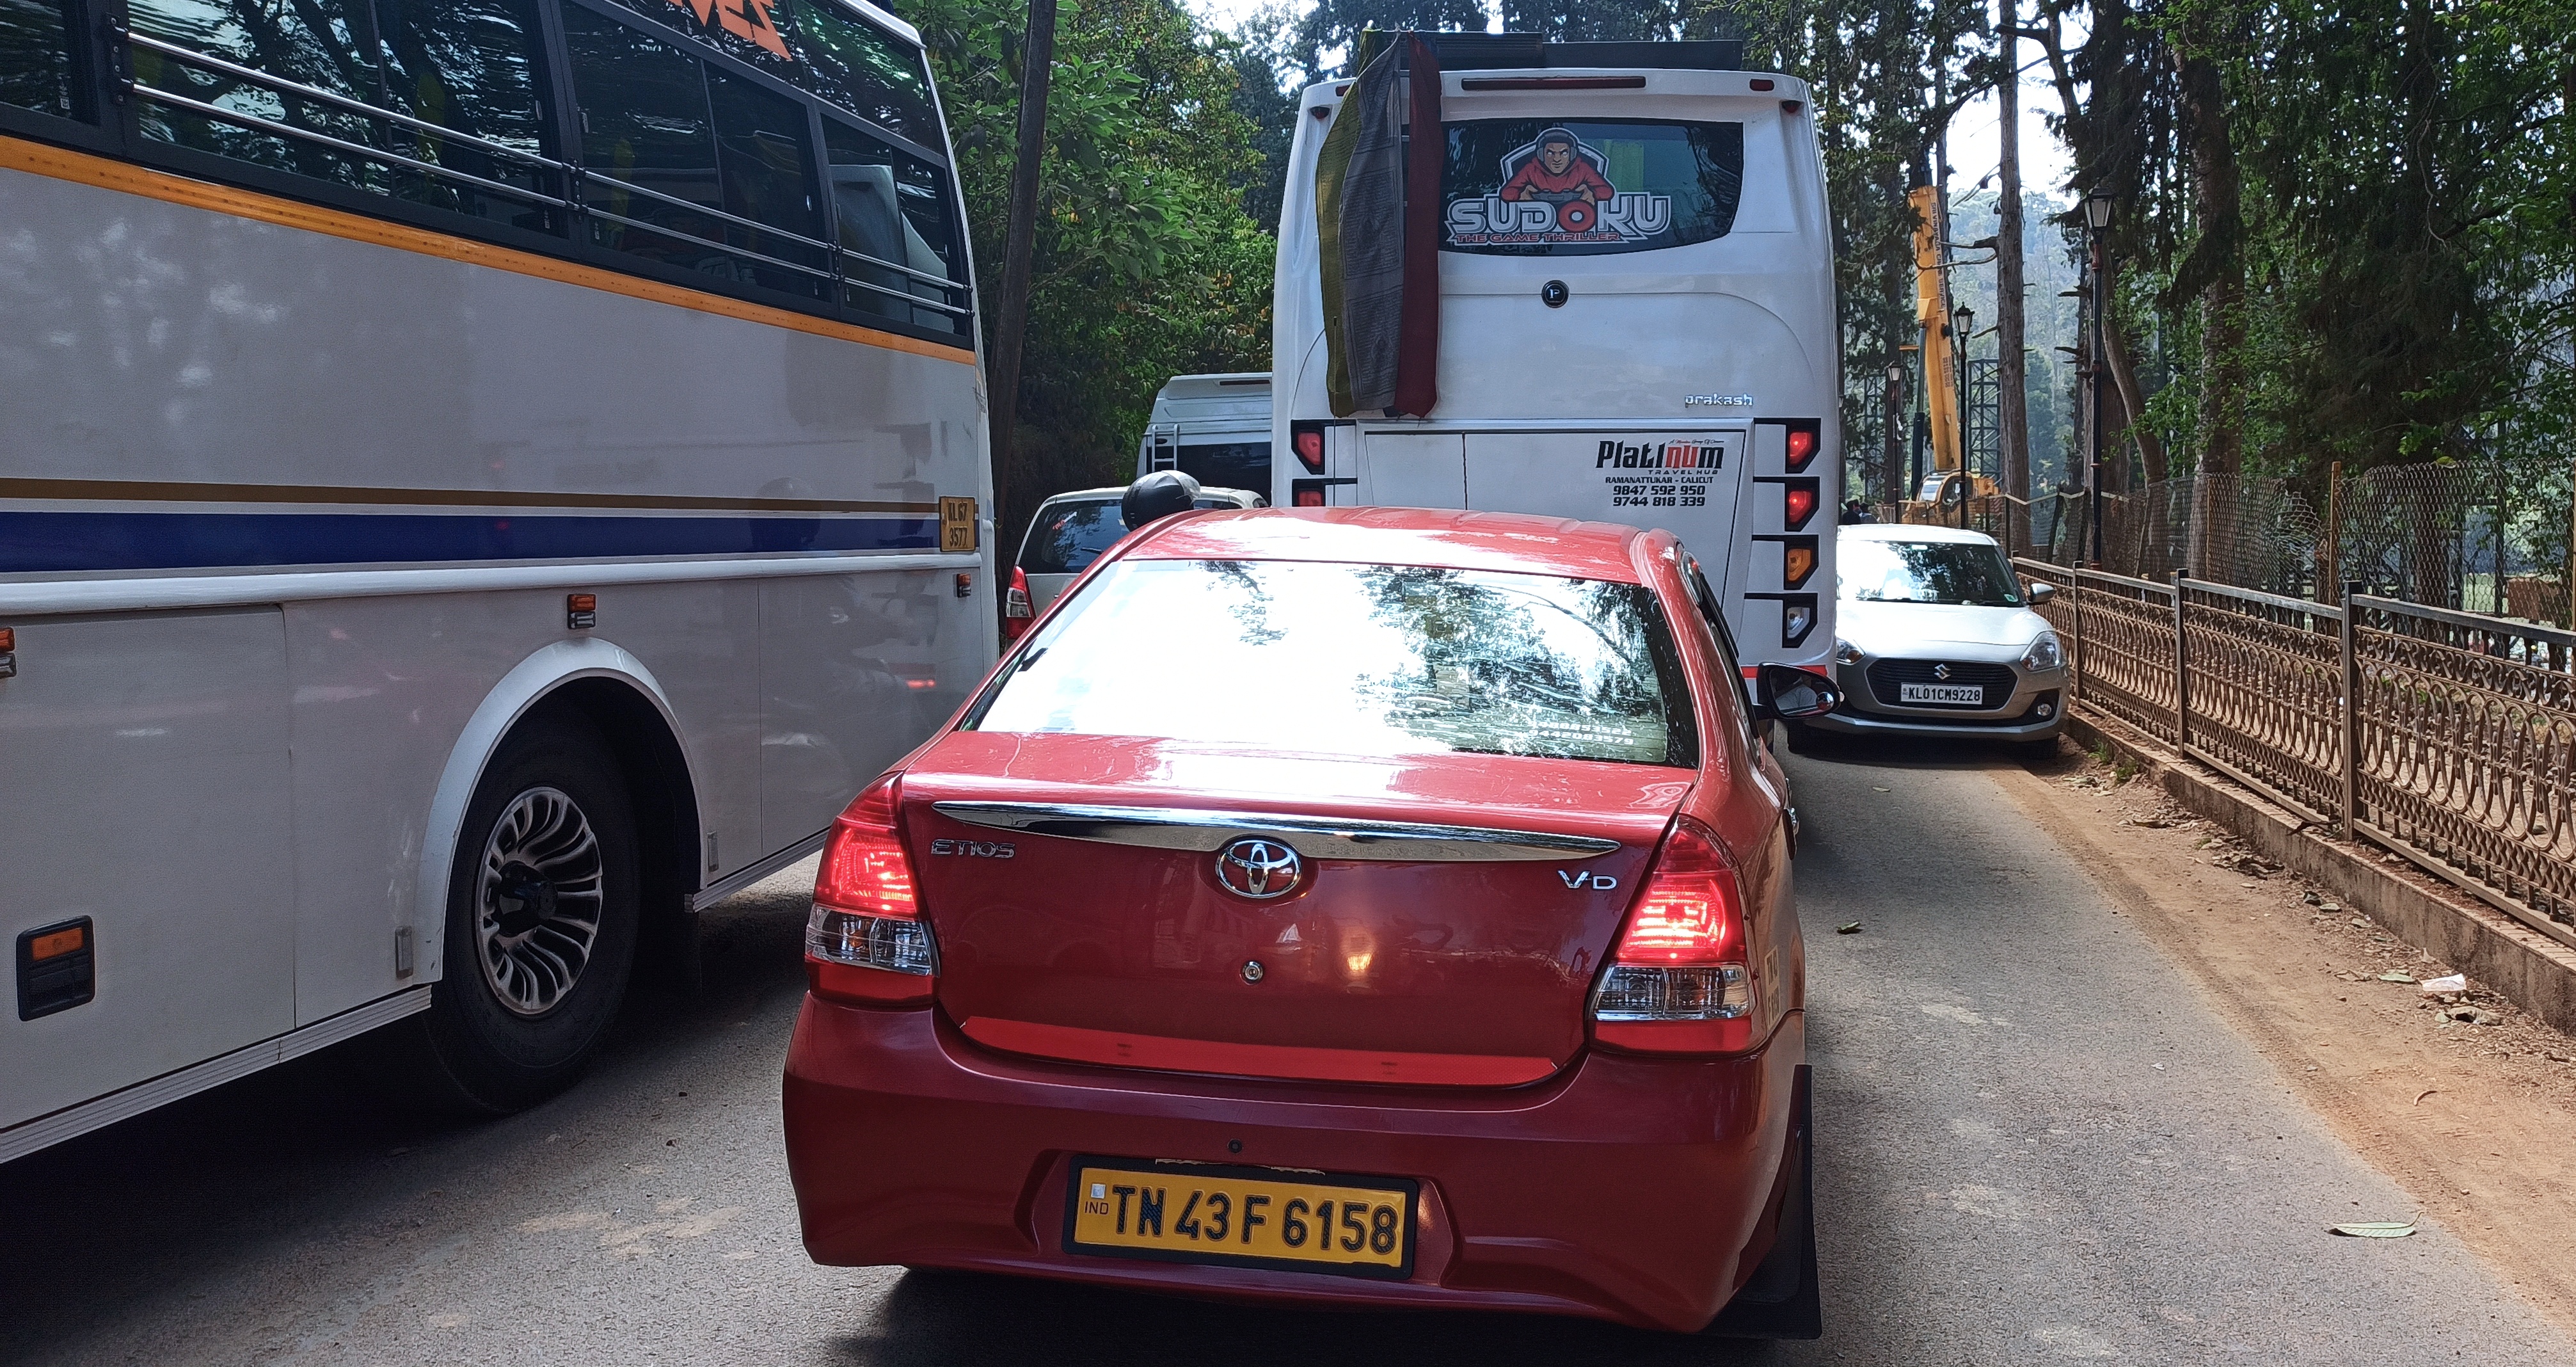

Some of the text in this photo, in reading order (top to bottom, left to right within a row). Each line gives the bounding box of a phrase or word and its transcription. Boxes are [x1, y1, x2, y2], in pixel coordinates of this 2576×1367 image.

[1449, 195, 1670, 235] SUDOKU
[1454, 232, 1621, 243] THE GAME THRILLER
[1685, 393, 1753, 408] prakash
[1612, 485, 1706, 495] 9847 592 950
[1612, 497, 1706, 507] 9744 818 339
[949, 527, 968, 547] 3577
[1909, 687, 1980, 701] KL01CM9228
[1527, 730, 1634, 745] 9442083579
[931, 838, 1015, 858] ETIOS
[1084, 1201, 1109, 1215] IND
[1113, 1186, 1397, 1255] TN 43 F 6158
